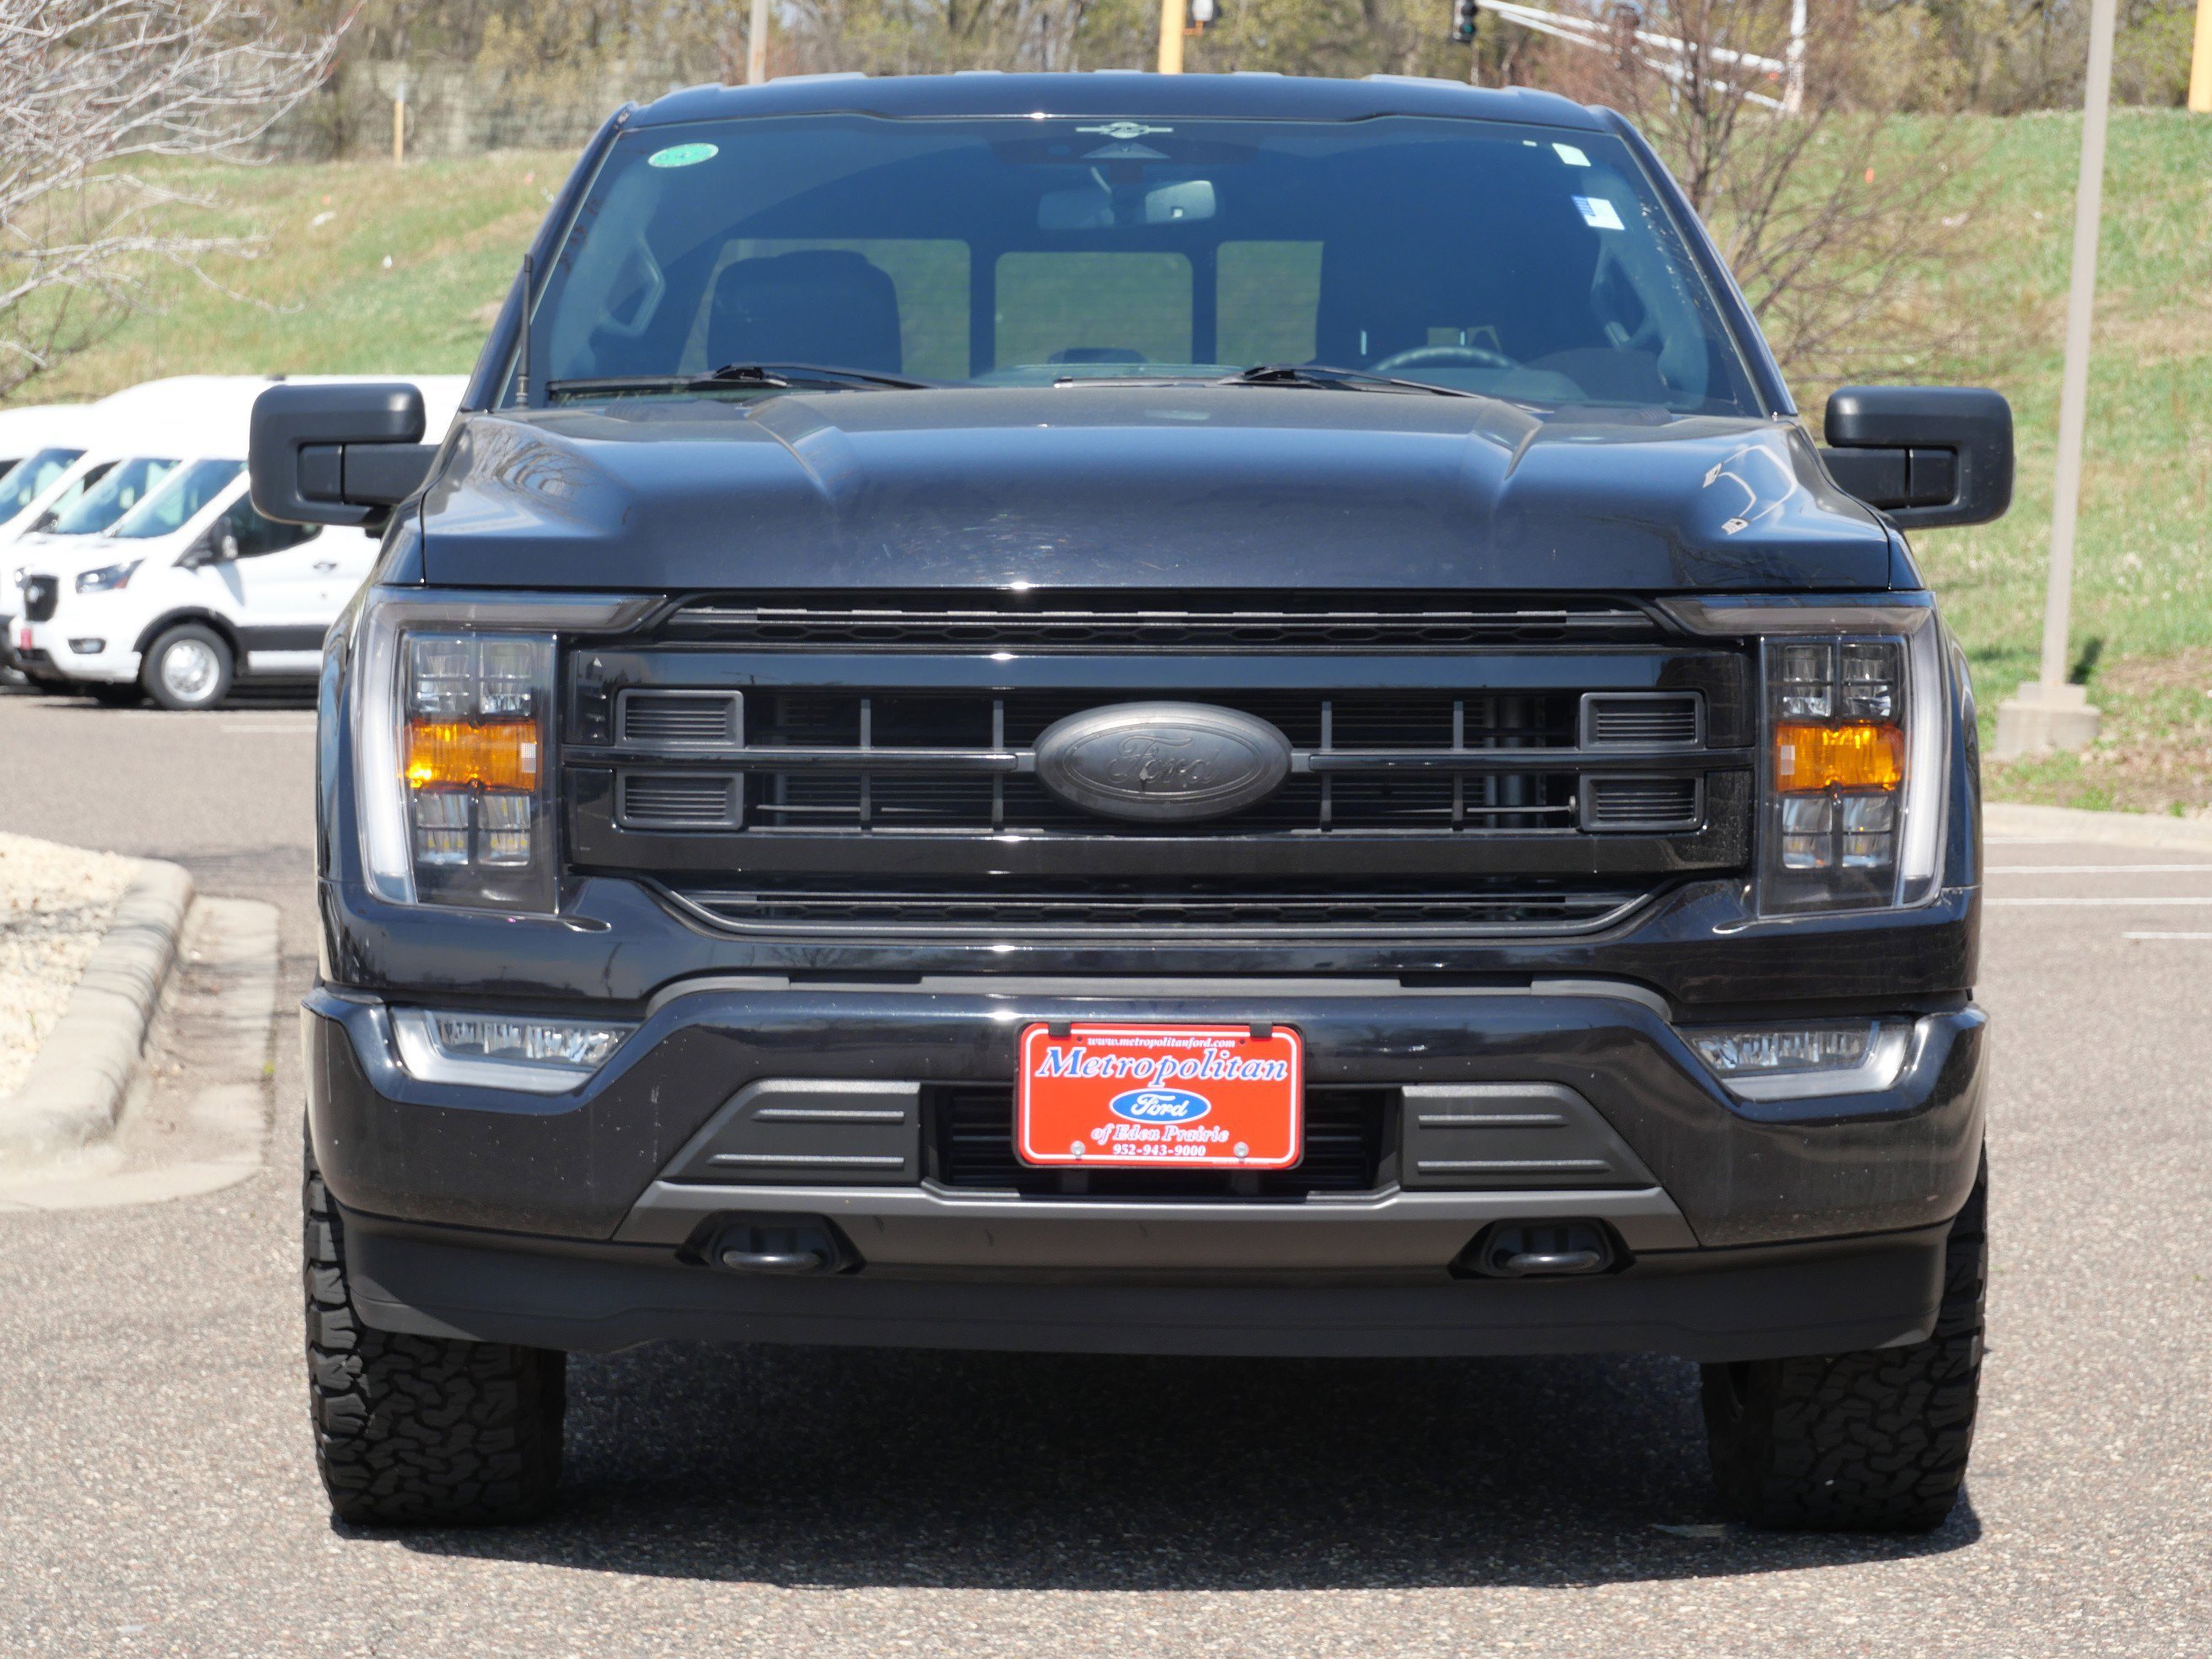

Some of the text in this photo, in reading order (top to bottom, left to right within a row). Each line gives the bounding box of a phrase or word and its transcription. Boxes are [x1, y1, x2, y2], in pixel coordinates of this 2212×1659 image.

[1106, 734, 1221, 784] Ford
[1087, 1037, 1236, 1050] www.metropolitanford.com
[1035, 1046, 1288, 1088] Metropolitan
[1130, 1093, 1188, 1118] Ford
[1091, 1123, 1230, 1146] of Eden Prairie
[1113, 1143, 1206, 1157] 952-943-9000
